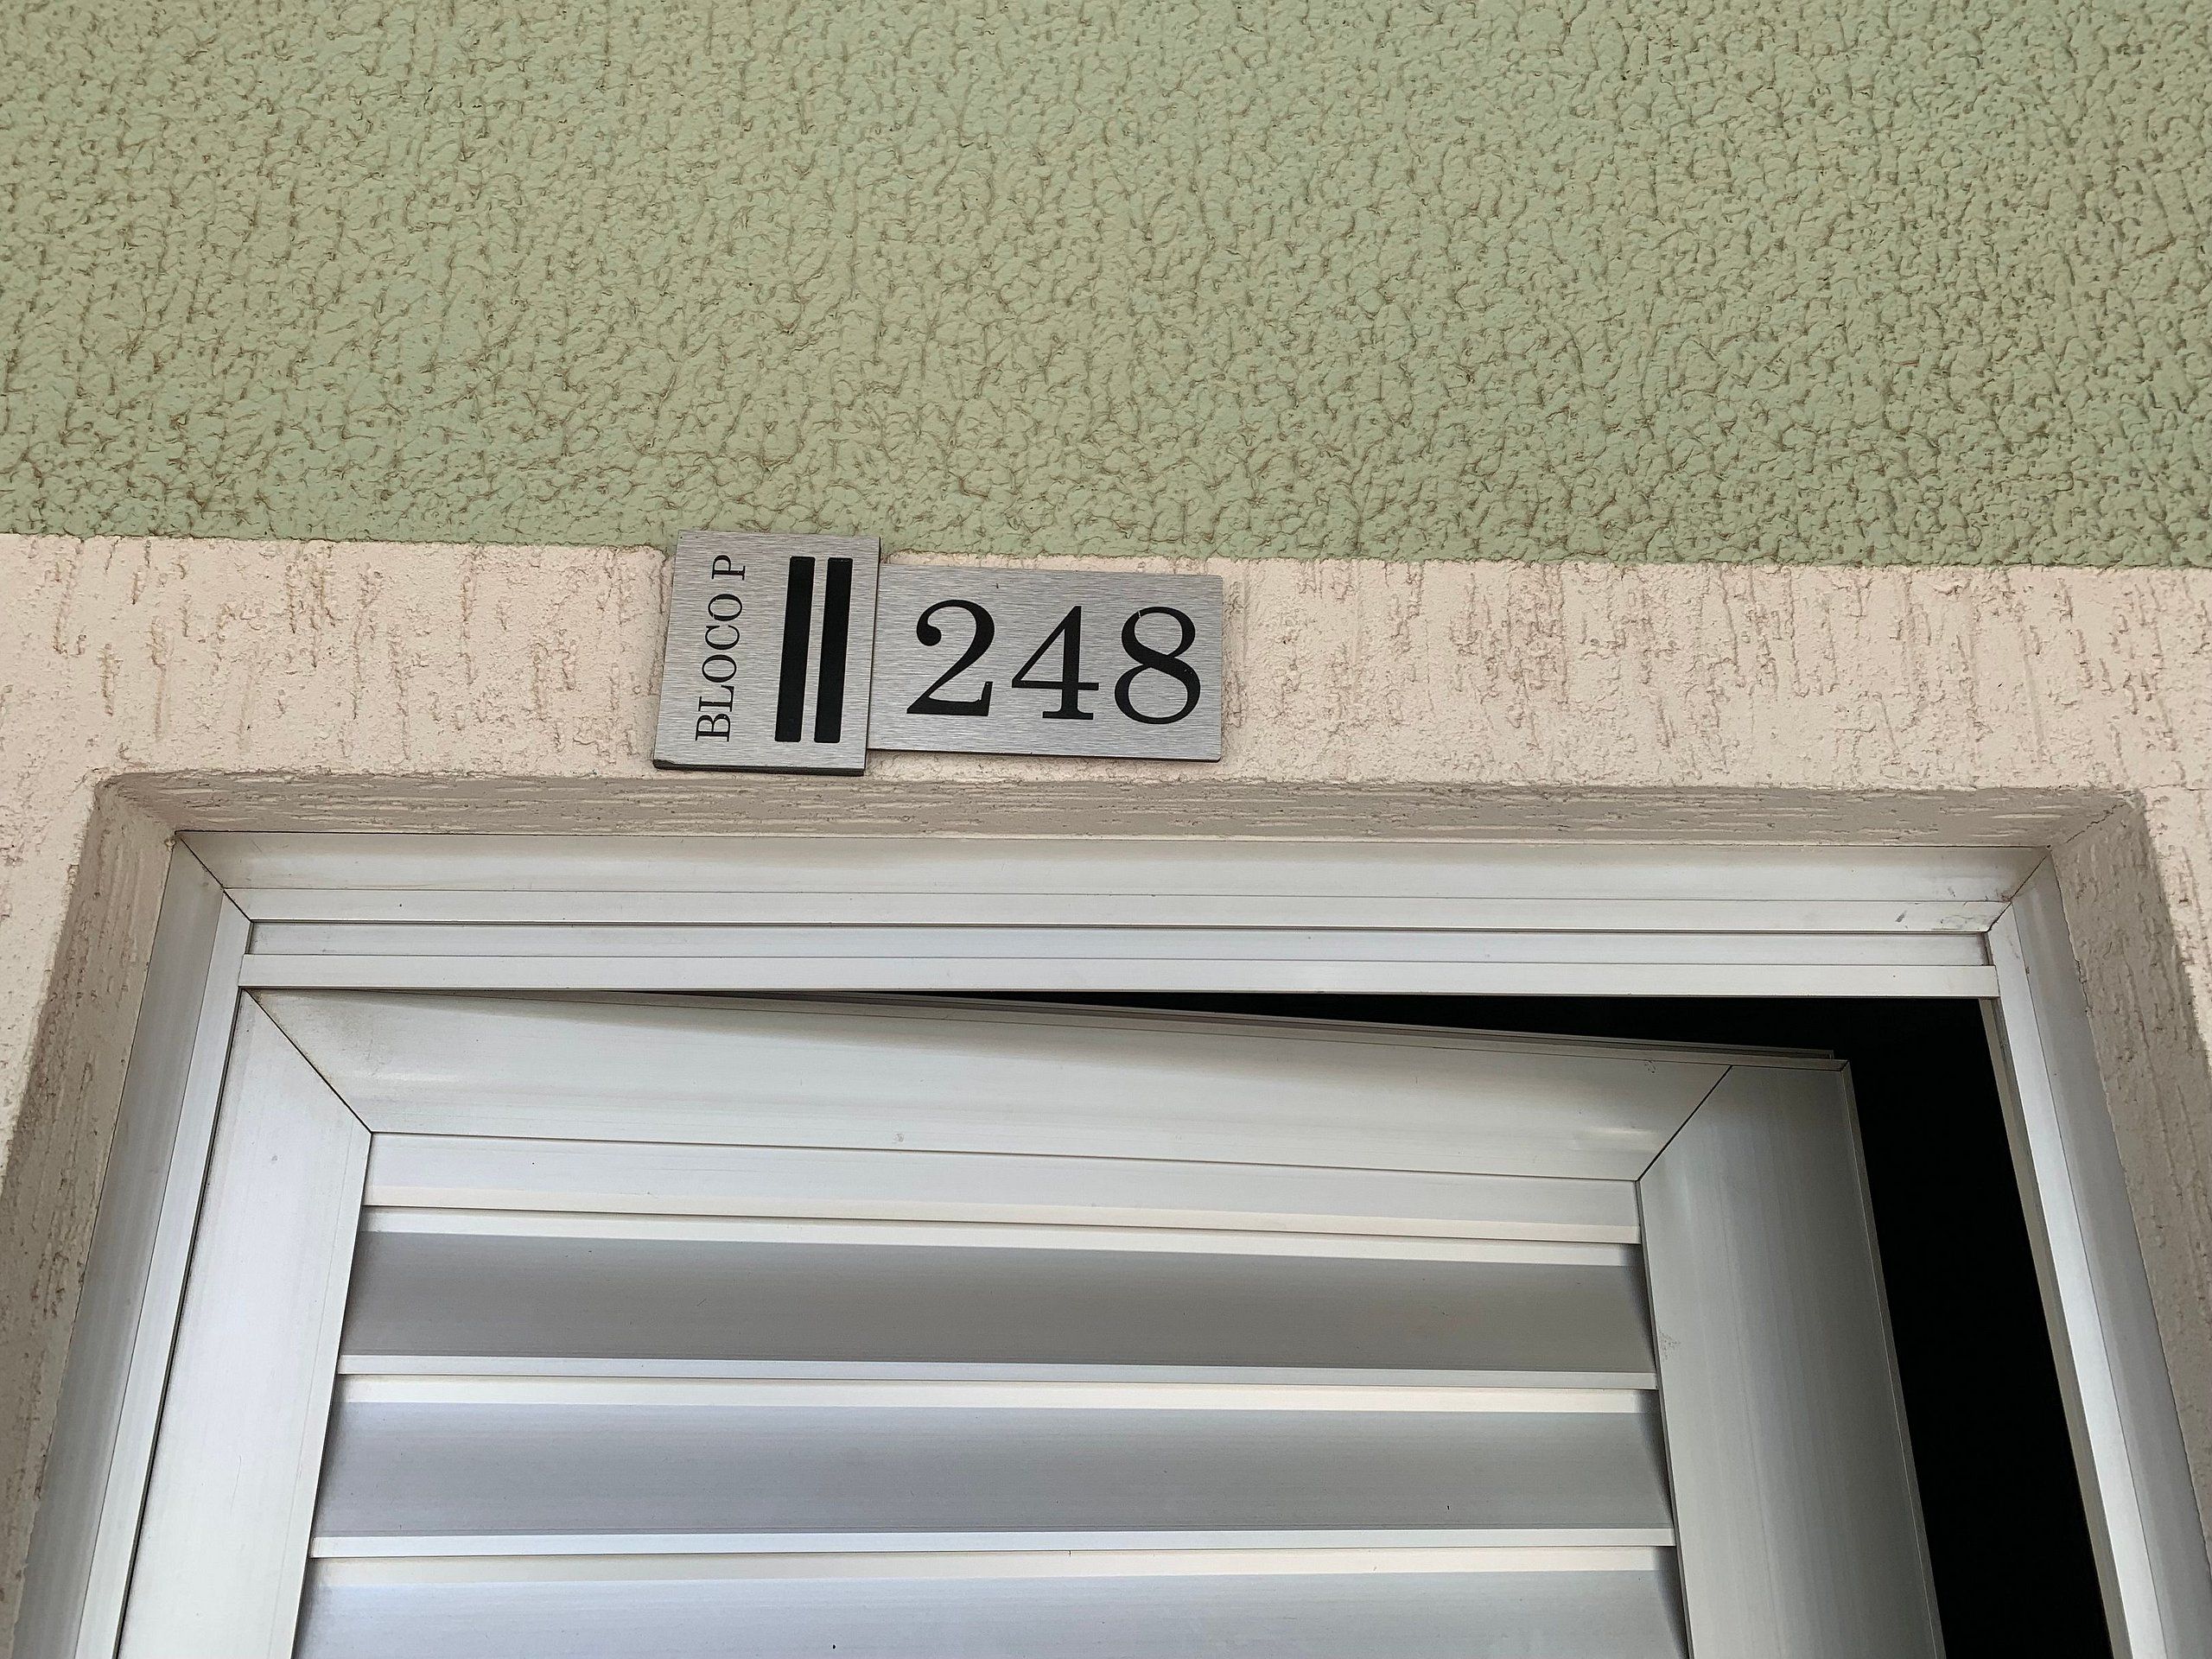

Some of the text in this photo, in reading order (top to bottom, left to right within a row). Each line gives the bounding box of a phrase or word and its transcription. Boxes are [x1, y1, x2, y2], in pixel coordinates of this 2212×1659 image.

[695, 554, 747, 742] BLOCO P
[906, 599, 1202, 725] 248
